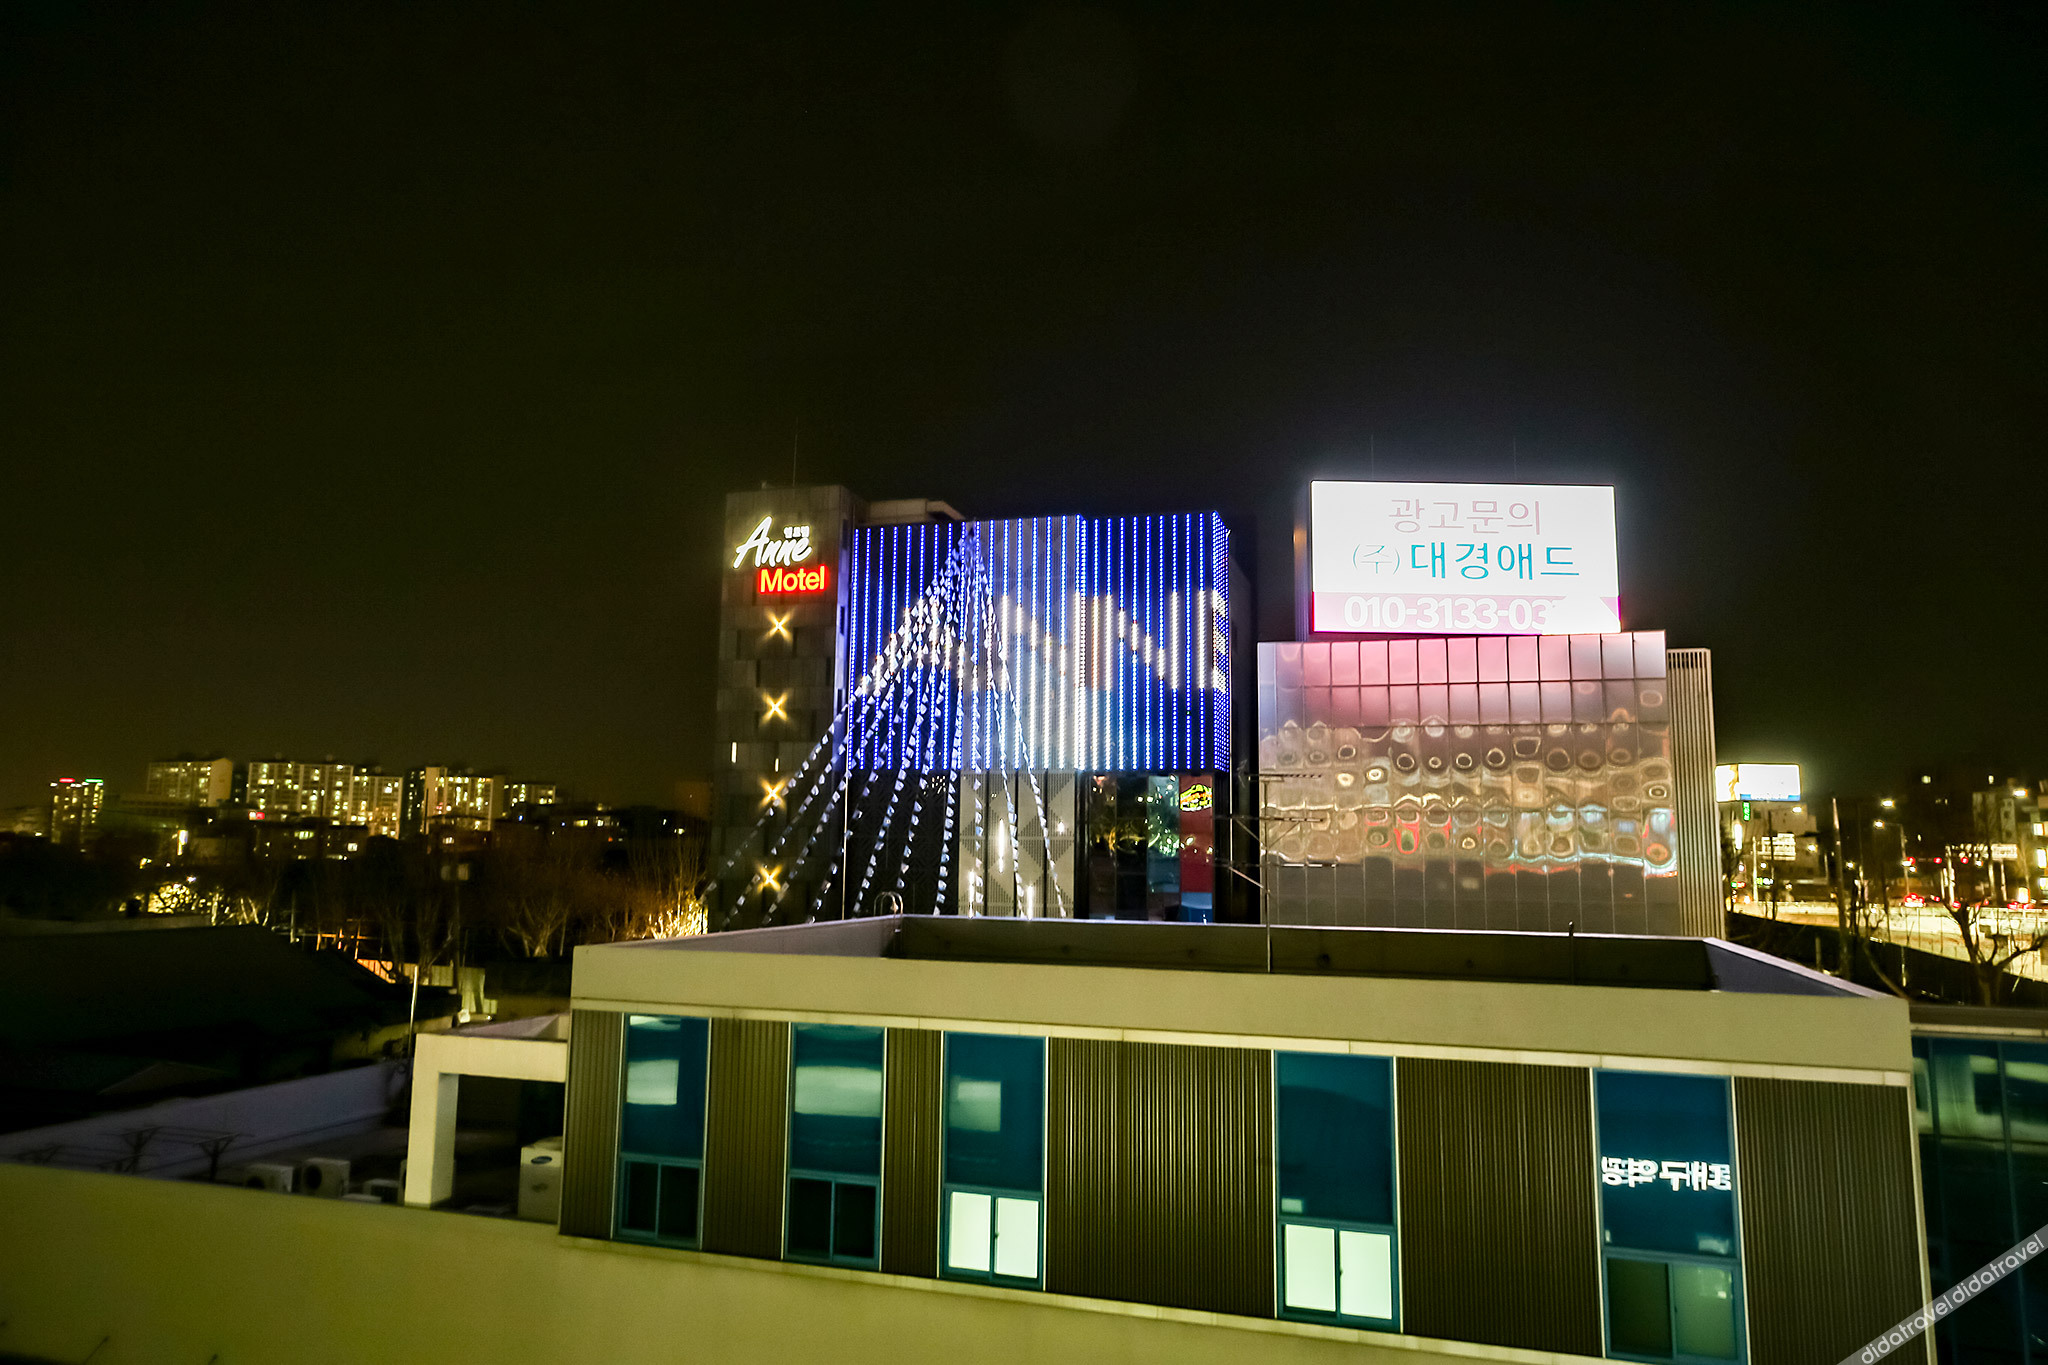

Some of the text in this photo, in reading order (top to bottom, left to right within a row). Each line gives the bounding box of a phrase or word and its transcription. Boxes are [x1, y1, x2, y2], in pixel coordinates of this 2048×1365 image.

[1388, 499, 1541, 535] 광고문의
[733, 515, 812, 569] Anne
[760, 565, 825, 593] Motel
[1343, 595, 1555, 631] 010-3133-03
